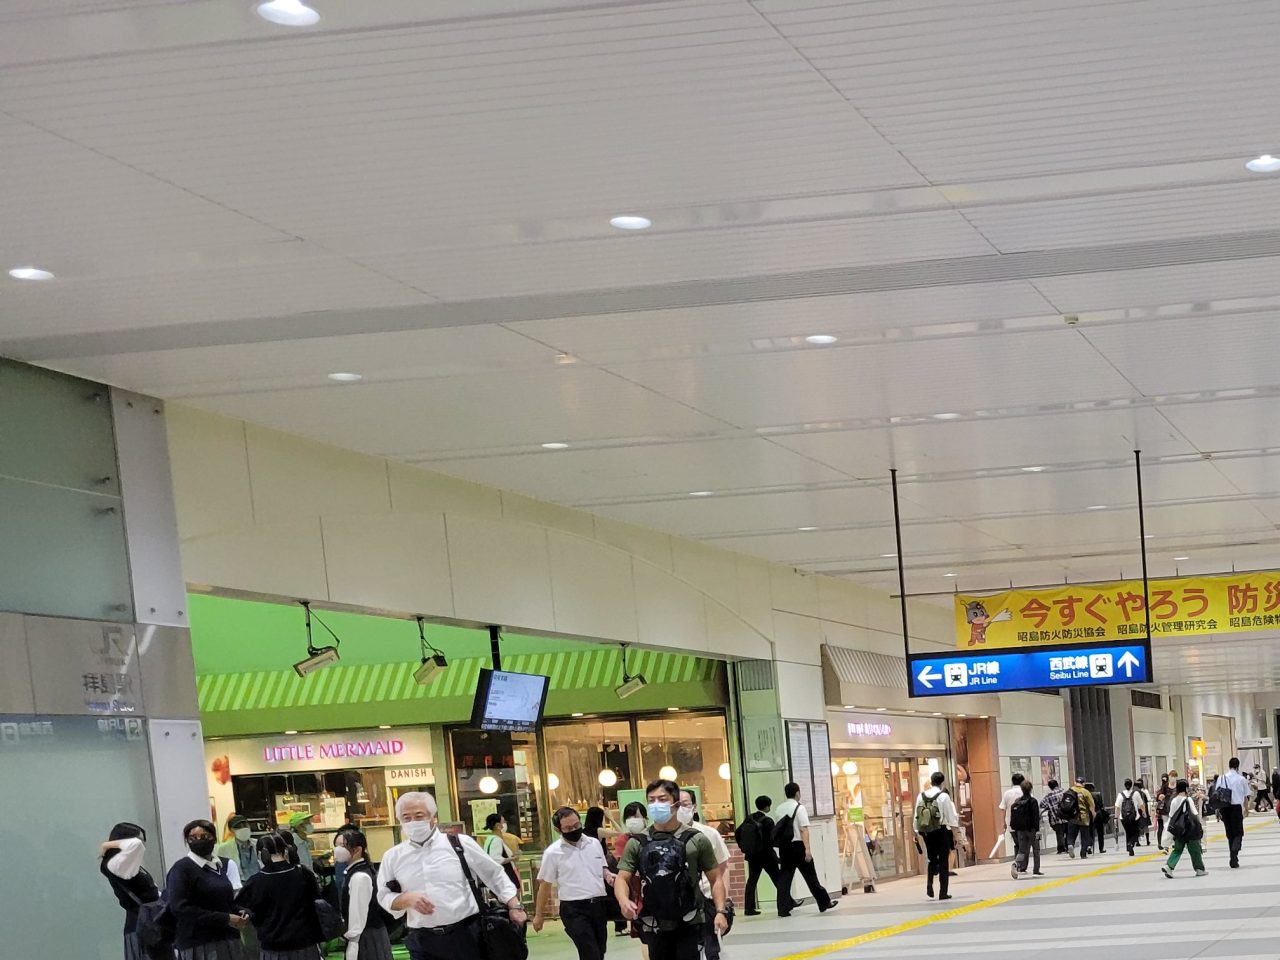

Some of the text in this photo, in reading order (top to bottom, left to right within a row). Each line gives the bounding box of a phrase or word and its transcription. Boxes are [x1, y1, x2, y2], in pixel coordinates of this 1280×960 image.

[1019, 587, 1209, 628] 今すぐやろう
[1017, 626, 1106, 642] 昭島防火防災協会
[1117, 618, 1218, 635] 昭島防火管理研究会
[967, 661, 1000, 676] JR線
[1048, 655, 1088, 671] 西武線
[969, 676, 998, 686] JR Line
[1049, 670, 1089, 681] Seibu Line
[264, 739, 404, 762] LITTLE MERMAID
[390, 767, 427, 780] DANISH
